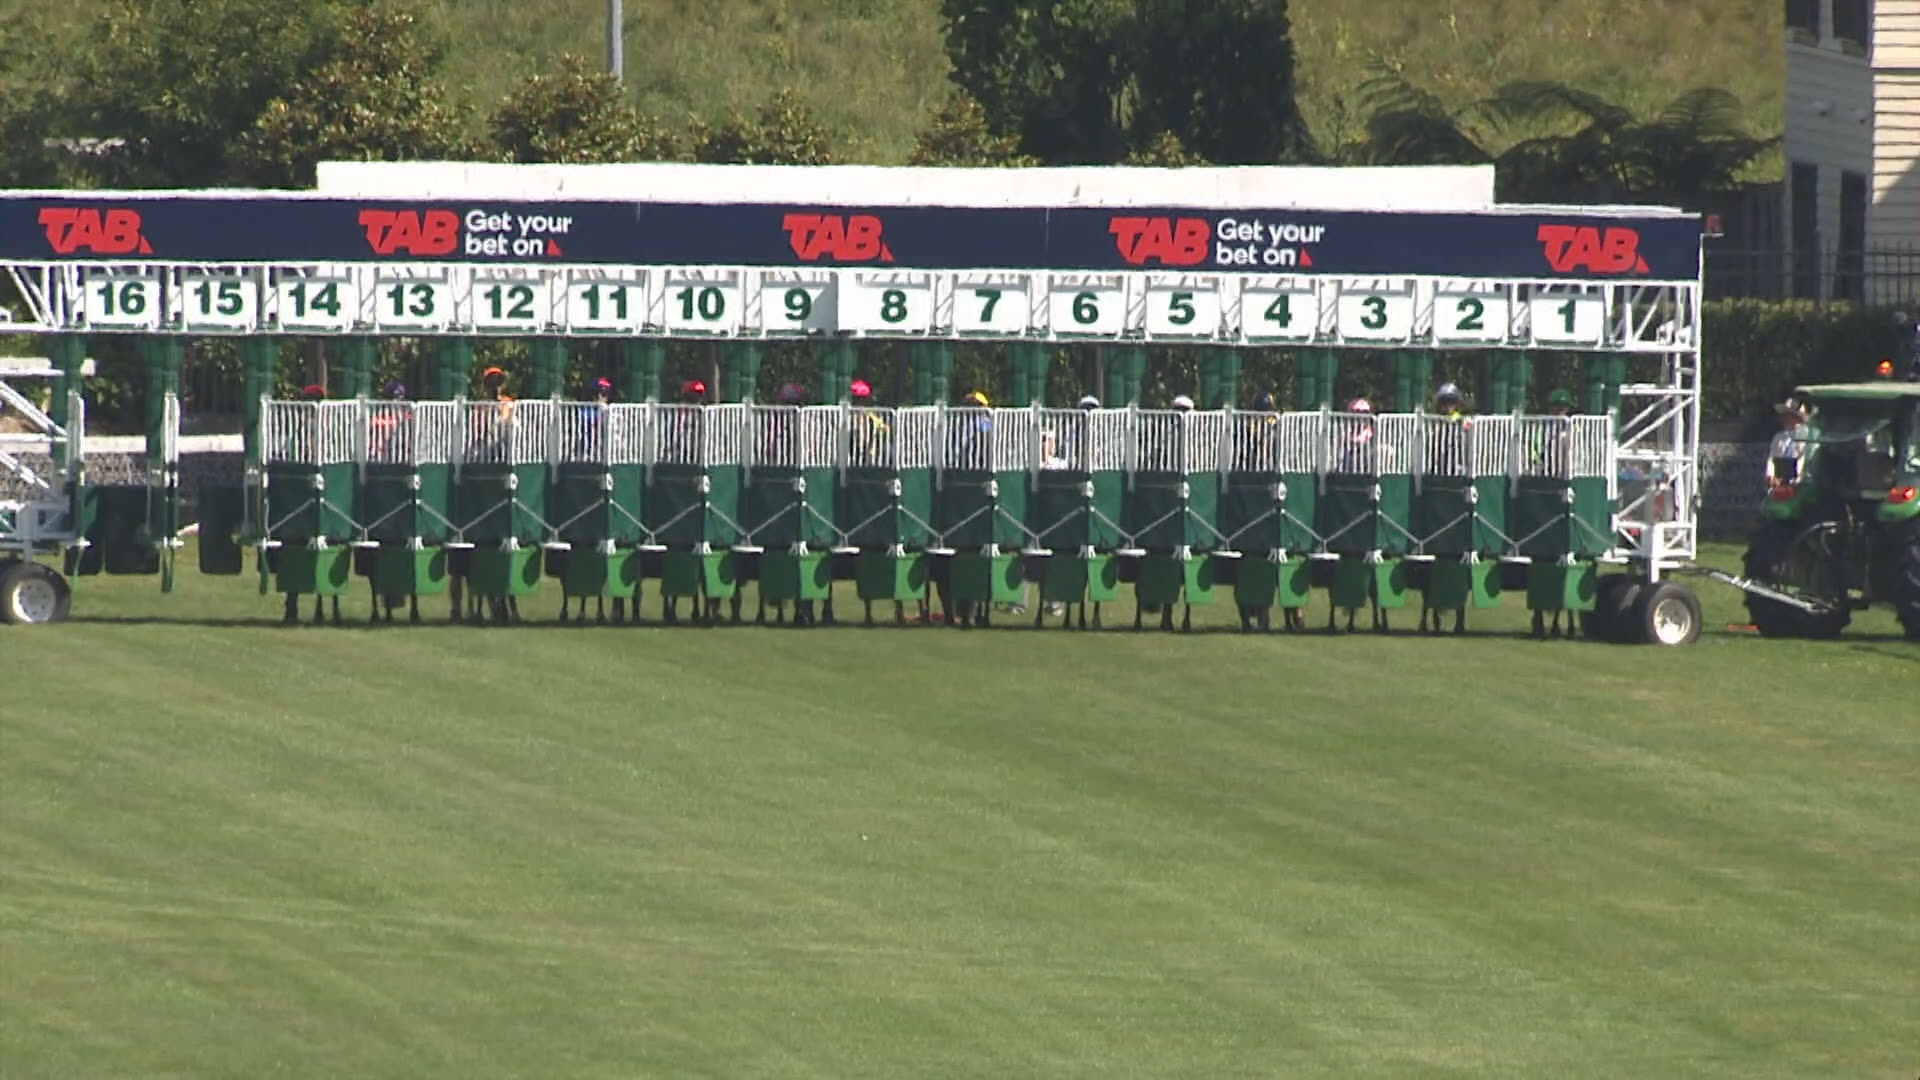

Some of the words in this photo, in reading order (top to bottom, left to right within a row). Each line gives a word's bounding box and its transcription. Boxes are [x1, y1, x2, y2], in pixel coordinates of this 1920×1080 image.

[39, 208, 141, 254] TAB
[359, 210, 459, 255] TAB
[465, 210, 512, 232] Get
[518, 213, 572, 236] your
[783, 214, 885, 261] TAB
[1216, 217, 1263, 242] Get
[1269, 222, 1325, 247] your
[465, 232, 508, 256] bet
[513, 236, 543, 256] on
[1109, 217, 1211, 265] TAB
[1216, 241, 1258, 266] bet
[1264, 247, 1296, 267] on
[1537, 224, 1639, 273] TAB
[98, 282, 146, 315] 16
[196, 282, 243, 315] 15
[288, 284, 341, 317] 14
[387, 284, 435, 317] 13
[484, 286, 534, 319] 12
[581, 286, 628, 320] 11
[676, 286, 725, 321] 10
[784, 288, 812, 322] 9
[881, 290, 908, 323] 8
[974, 290, 1002, 323] 7
[1072, 292, 1099, 325] 6
[1168, 293, 1195, 326] 5
[1264, 295, 1293, 328] 4
[1360, 296, 1387, 330] 3
[1456, 298, 1484, 331] 2
[1557, 300, 1576, 333] 1
